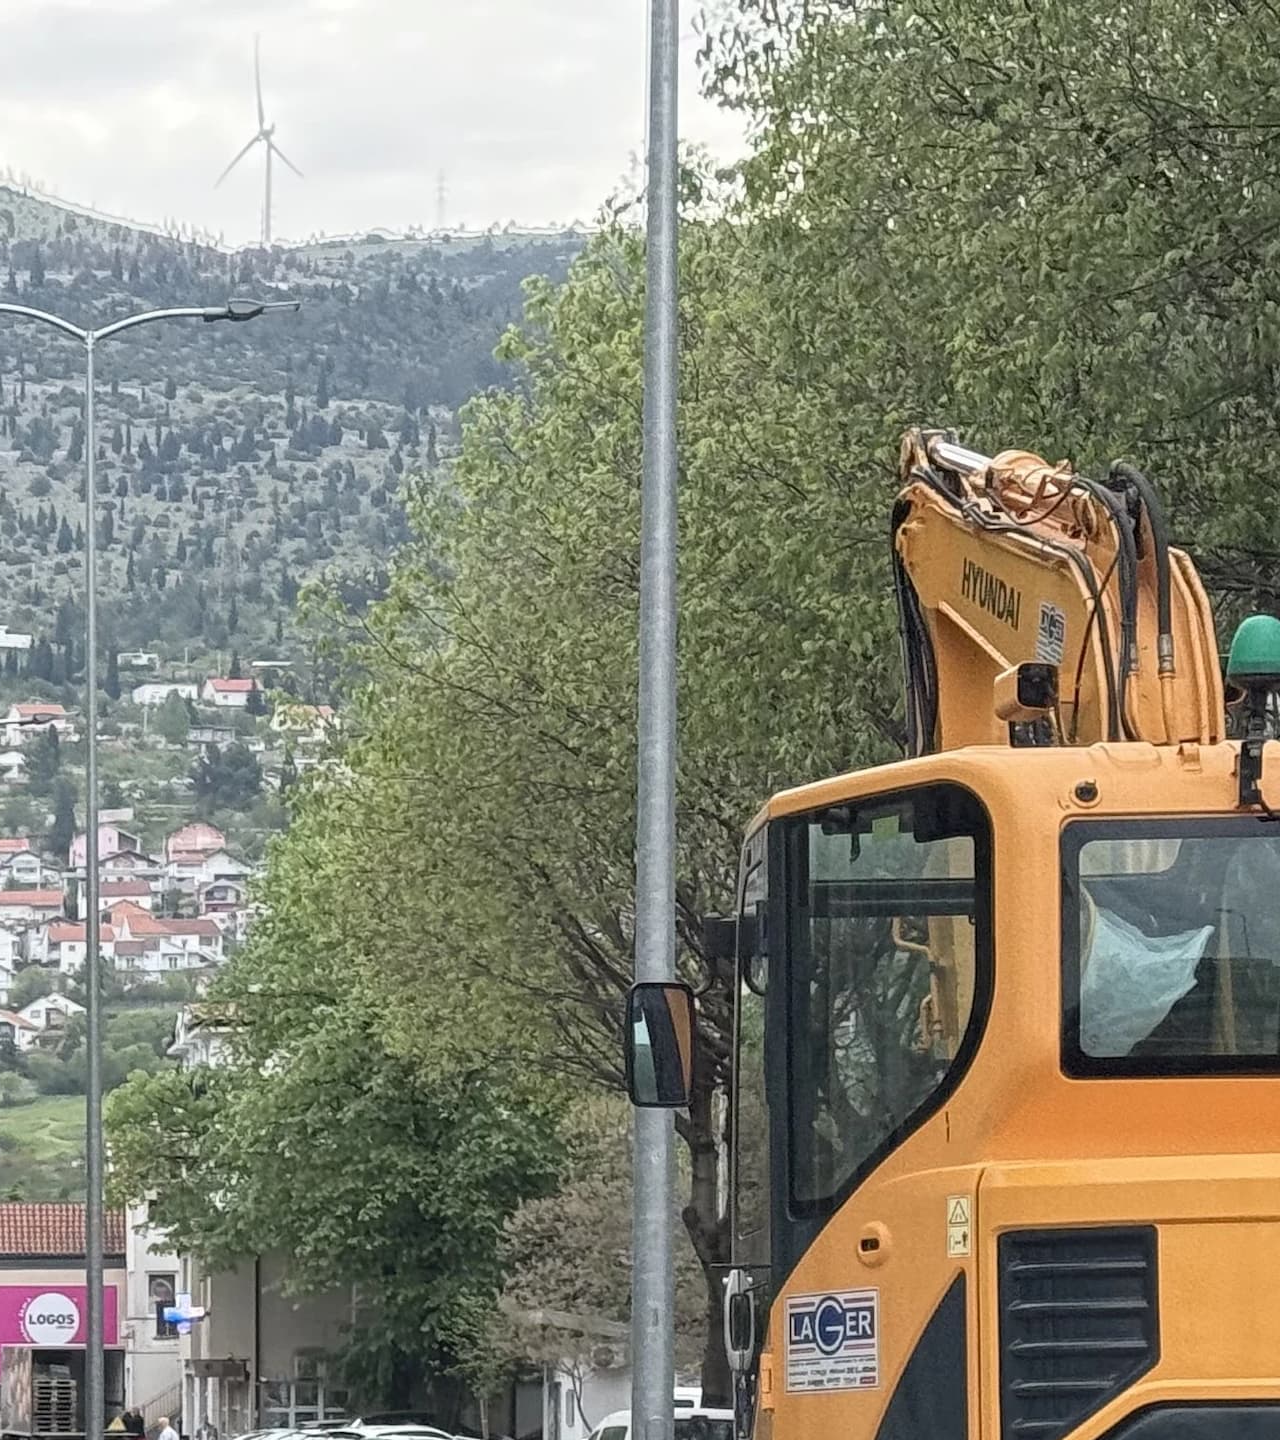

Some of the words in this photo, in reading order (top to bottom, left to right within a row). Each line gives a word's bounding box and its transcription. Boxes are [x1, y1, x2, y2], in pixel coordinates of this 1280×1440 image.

[961, 557, 1021, 631] HYUNDAI
[28, 1313, 75, 1325] LOGOS
[790, 1299, 872, 1352] LAGER
